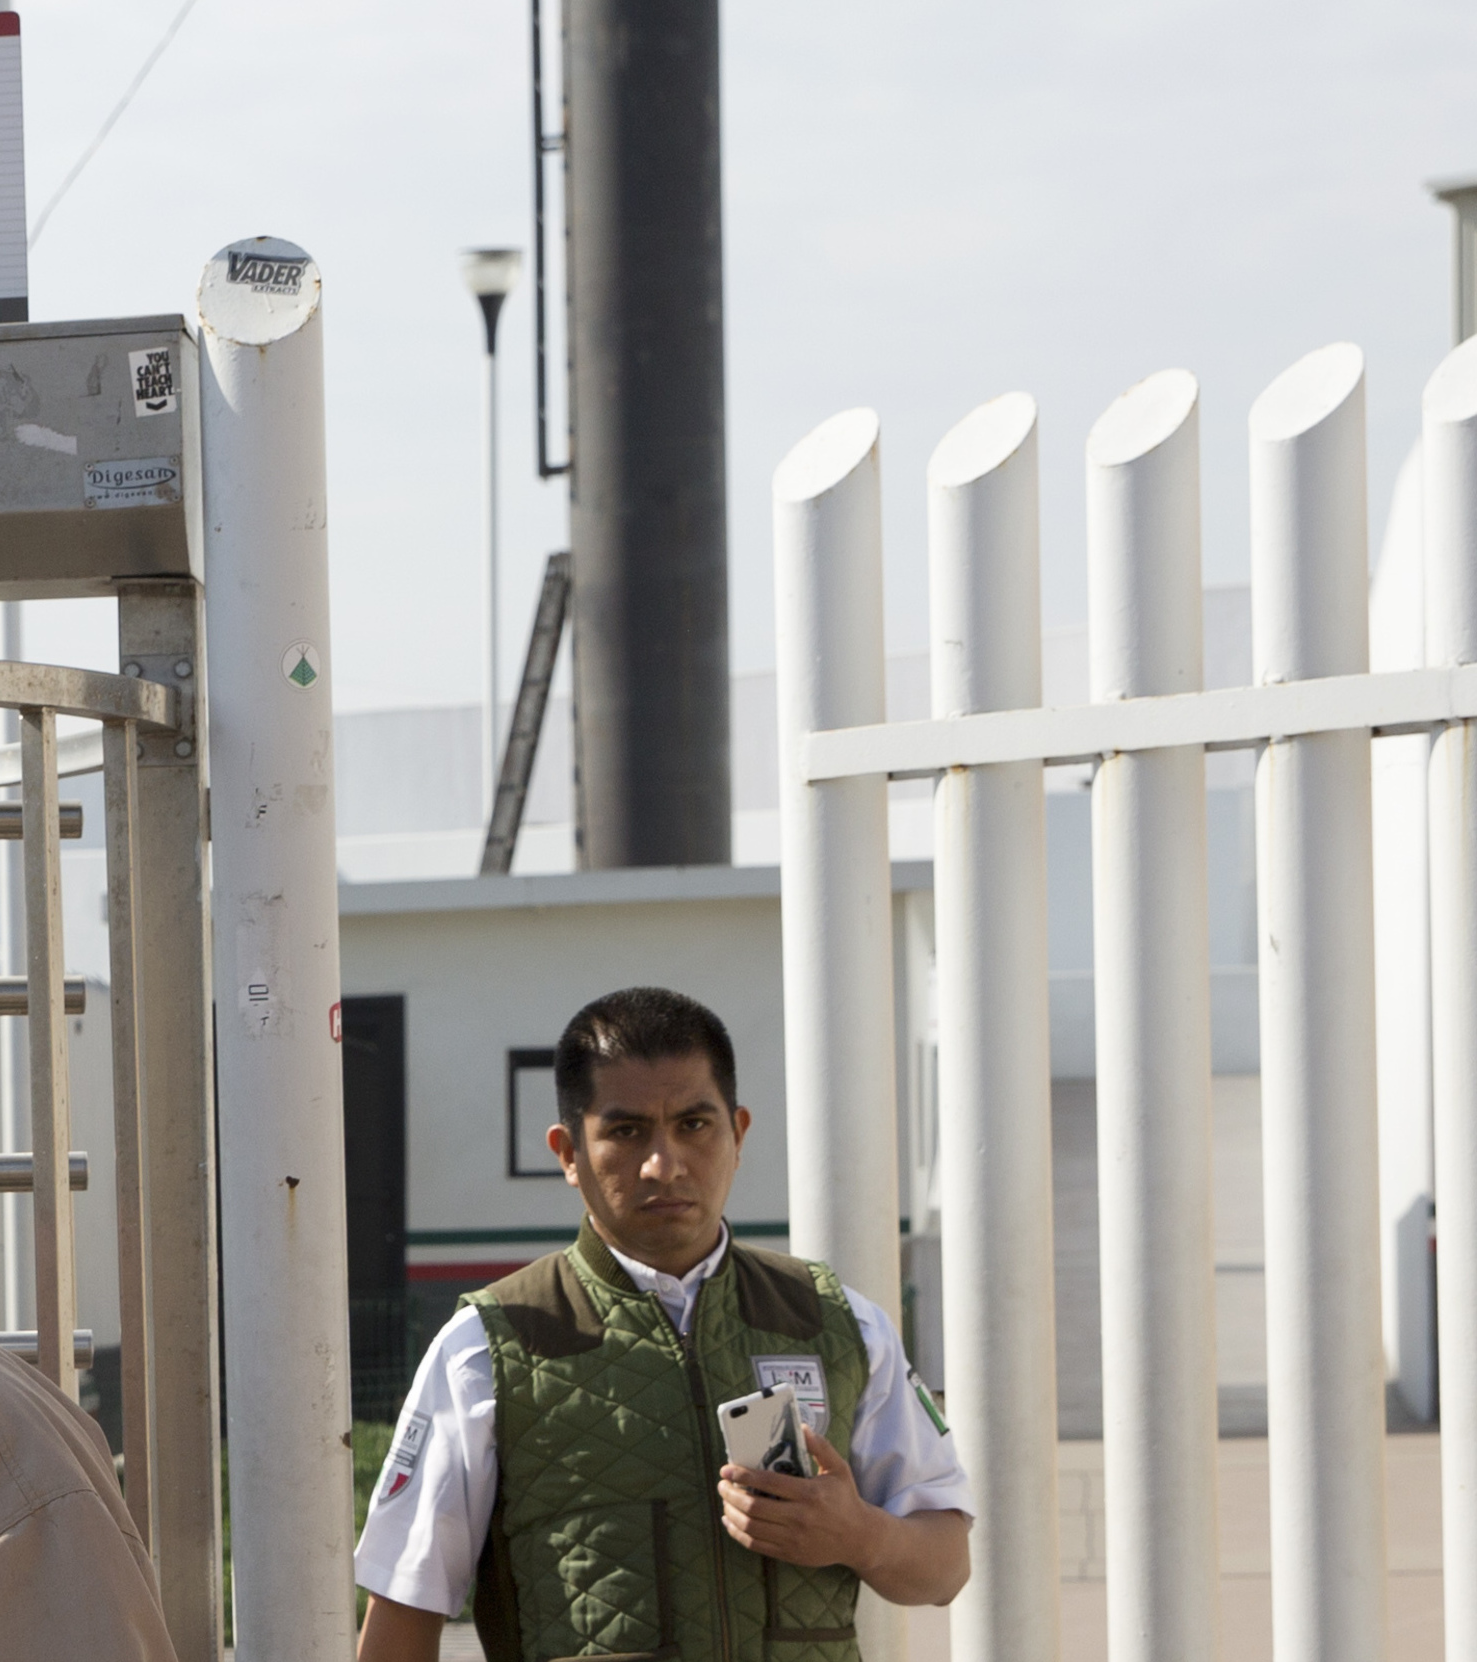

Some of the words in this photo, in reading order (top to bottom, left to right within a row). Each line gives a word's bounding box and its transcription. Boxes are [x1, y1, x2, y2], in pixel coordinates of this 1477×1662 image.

[228, 252, 303, 287] VADER
[146, 351, 169, 364] YOU
[137, 362, 170, 377] CAN'T
[137, 374, 172, 390] TEACH
[89, 466, 169, 487] Digesan
